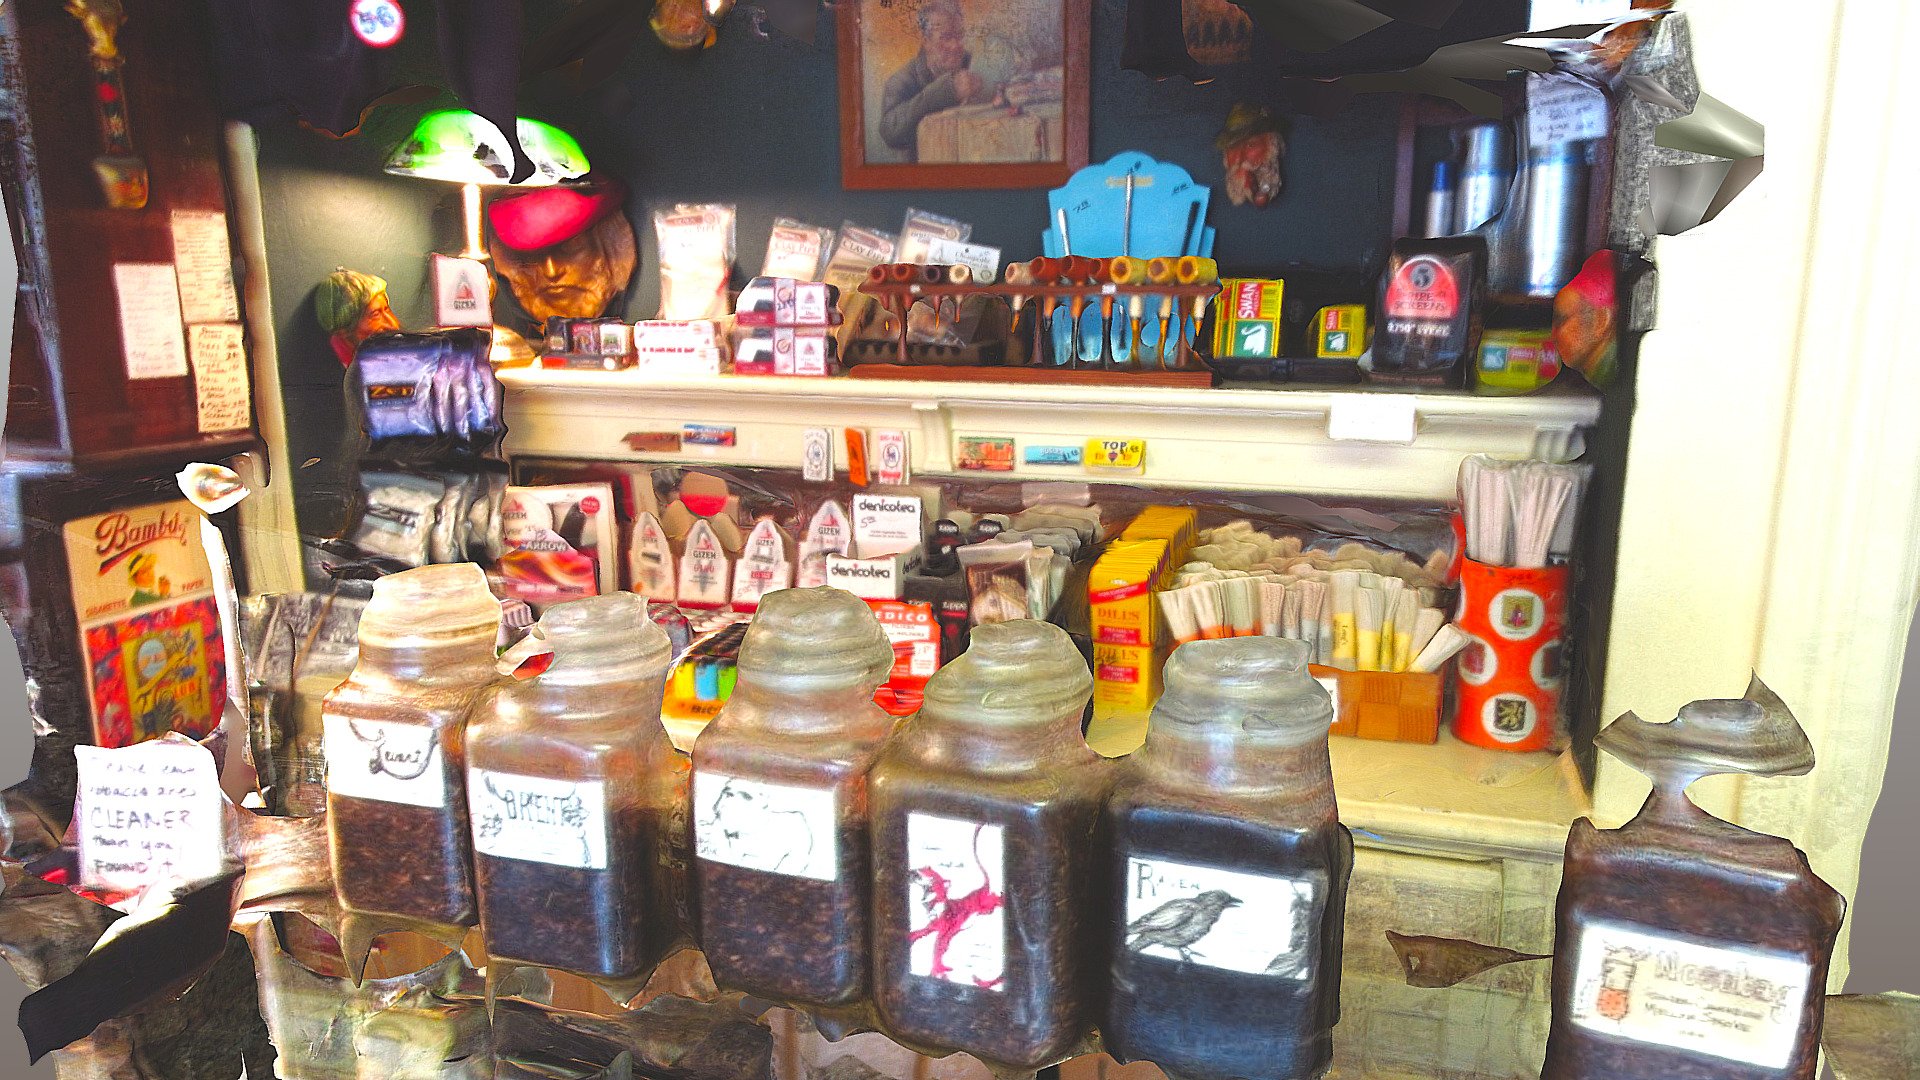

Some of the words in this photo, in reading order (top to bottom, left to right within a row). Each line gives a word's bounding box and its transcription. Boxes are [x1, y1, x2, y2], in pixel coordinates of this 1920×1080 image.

[841, 239, 867, 256] CLAY
[1238, 283, 1258, 319] SWAN
[1103, 441, 1127, 450] TOP
[859, 499, 916, 513] denicotea
[526, 541, 567, 551] ARROW
[831, 563, 890, 578] denicotea
[91, 807, 193, 829] CLEANER
[1132, 861, 1201, 900] RAEN
